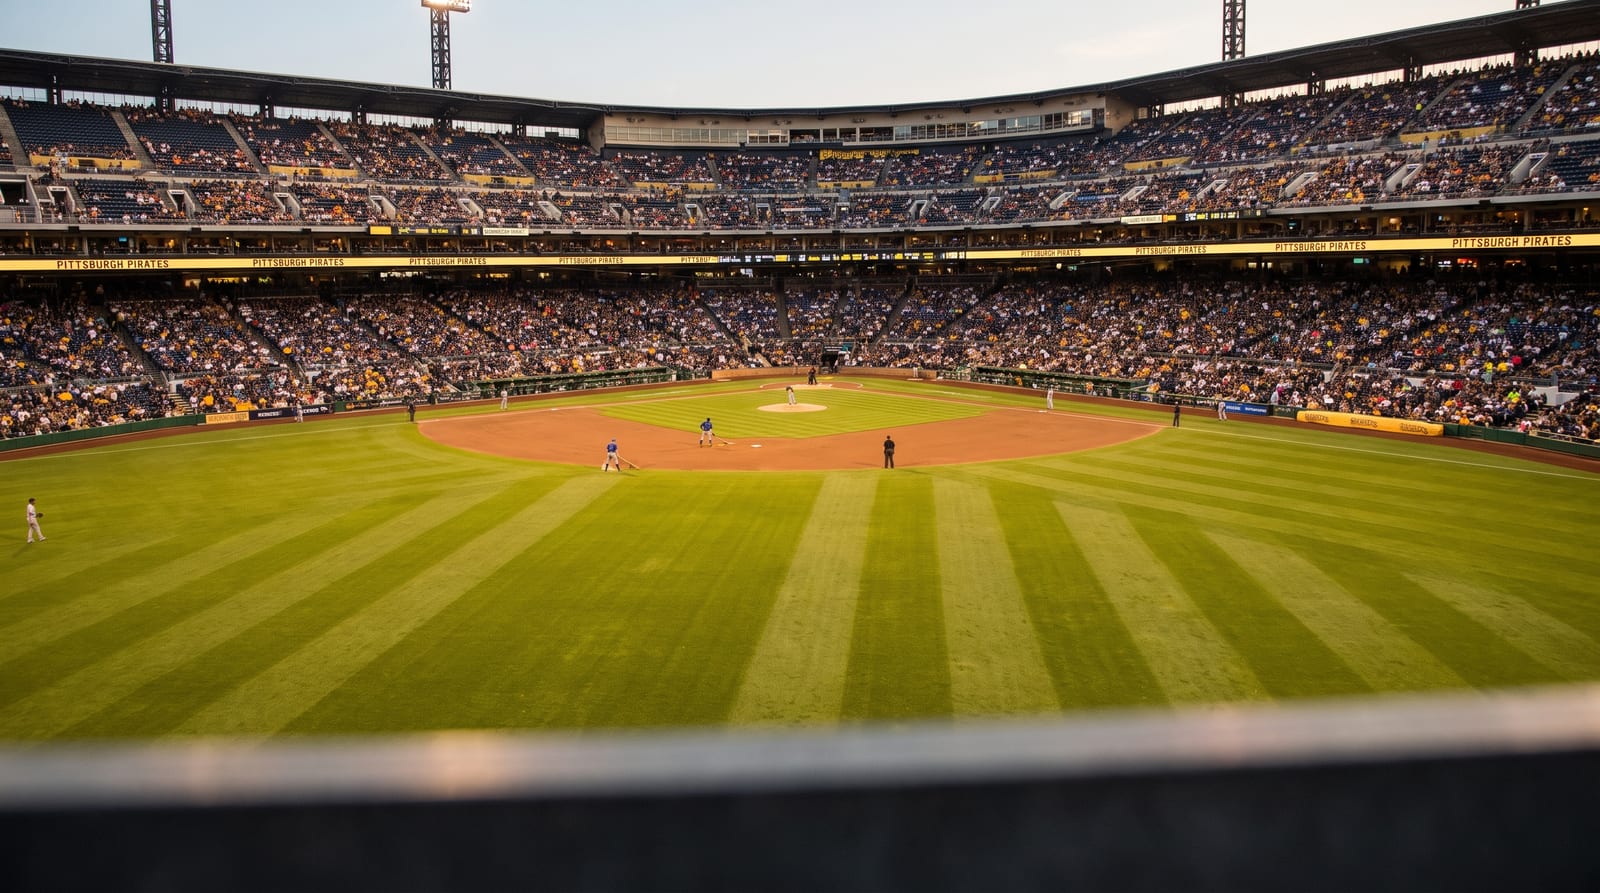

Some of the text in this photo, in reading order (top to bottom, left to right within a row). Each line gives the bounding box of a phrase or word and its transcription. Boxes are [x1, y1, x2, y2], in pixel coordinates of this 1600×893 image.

[1452, 236, 1572, 248] PITTSBURGH PIRATES
[1136, 246, 1175, 254] PITTSBURGH
[1276, 243, 1326, 251] PITTSBURGH
[57, 260, 168, 269] PITTSBURGH PIRATES
